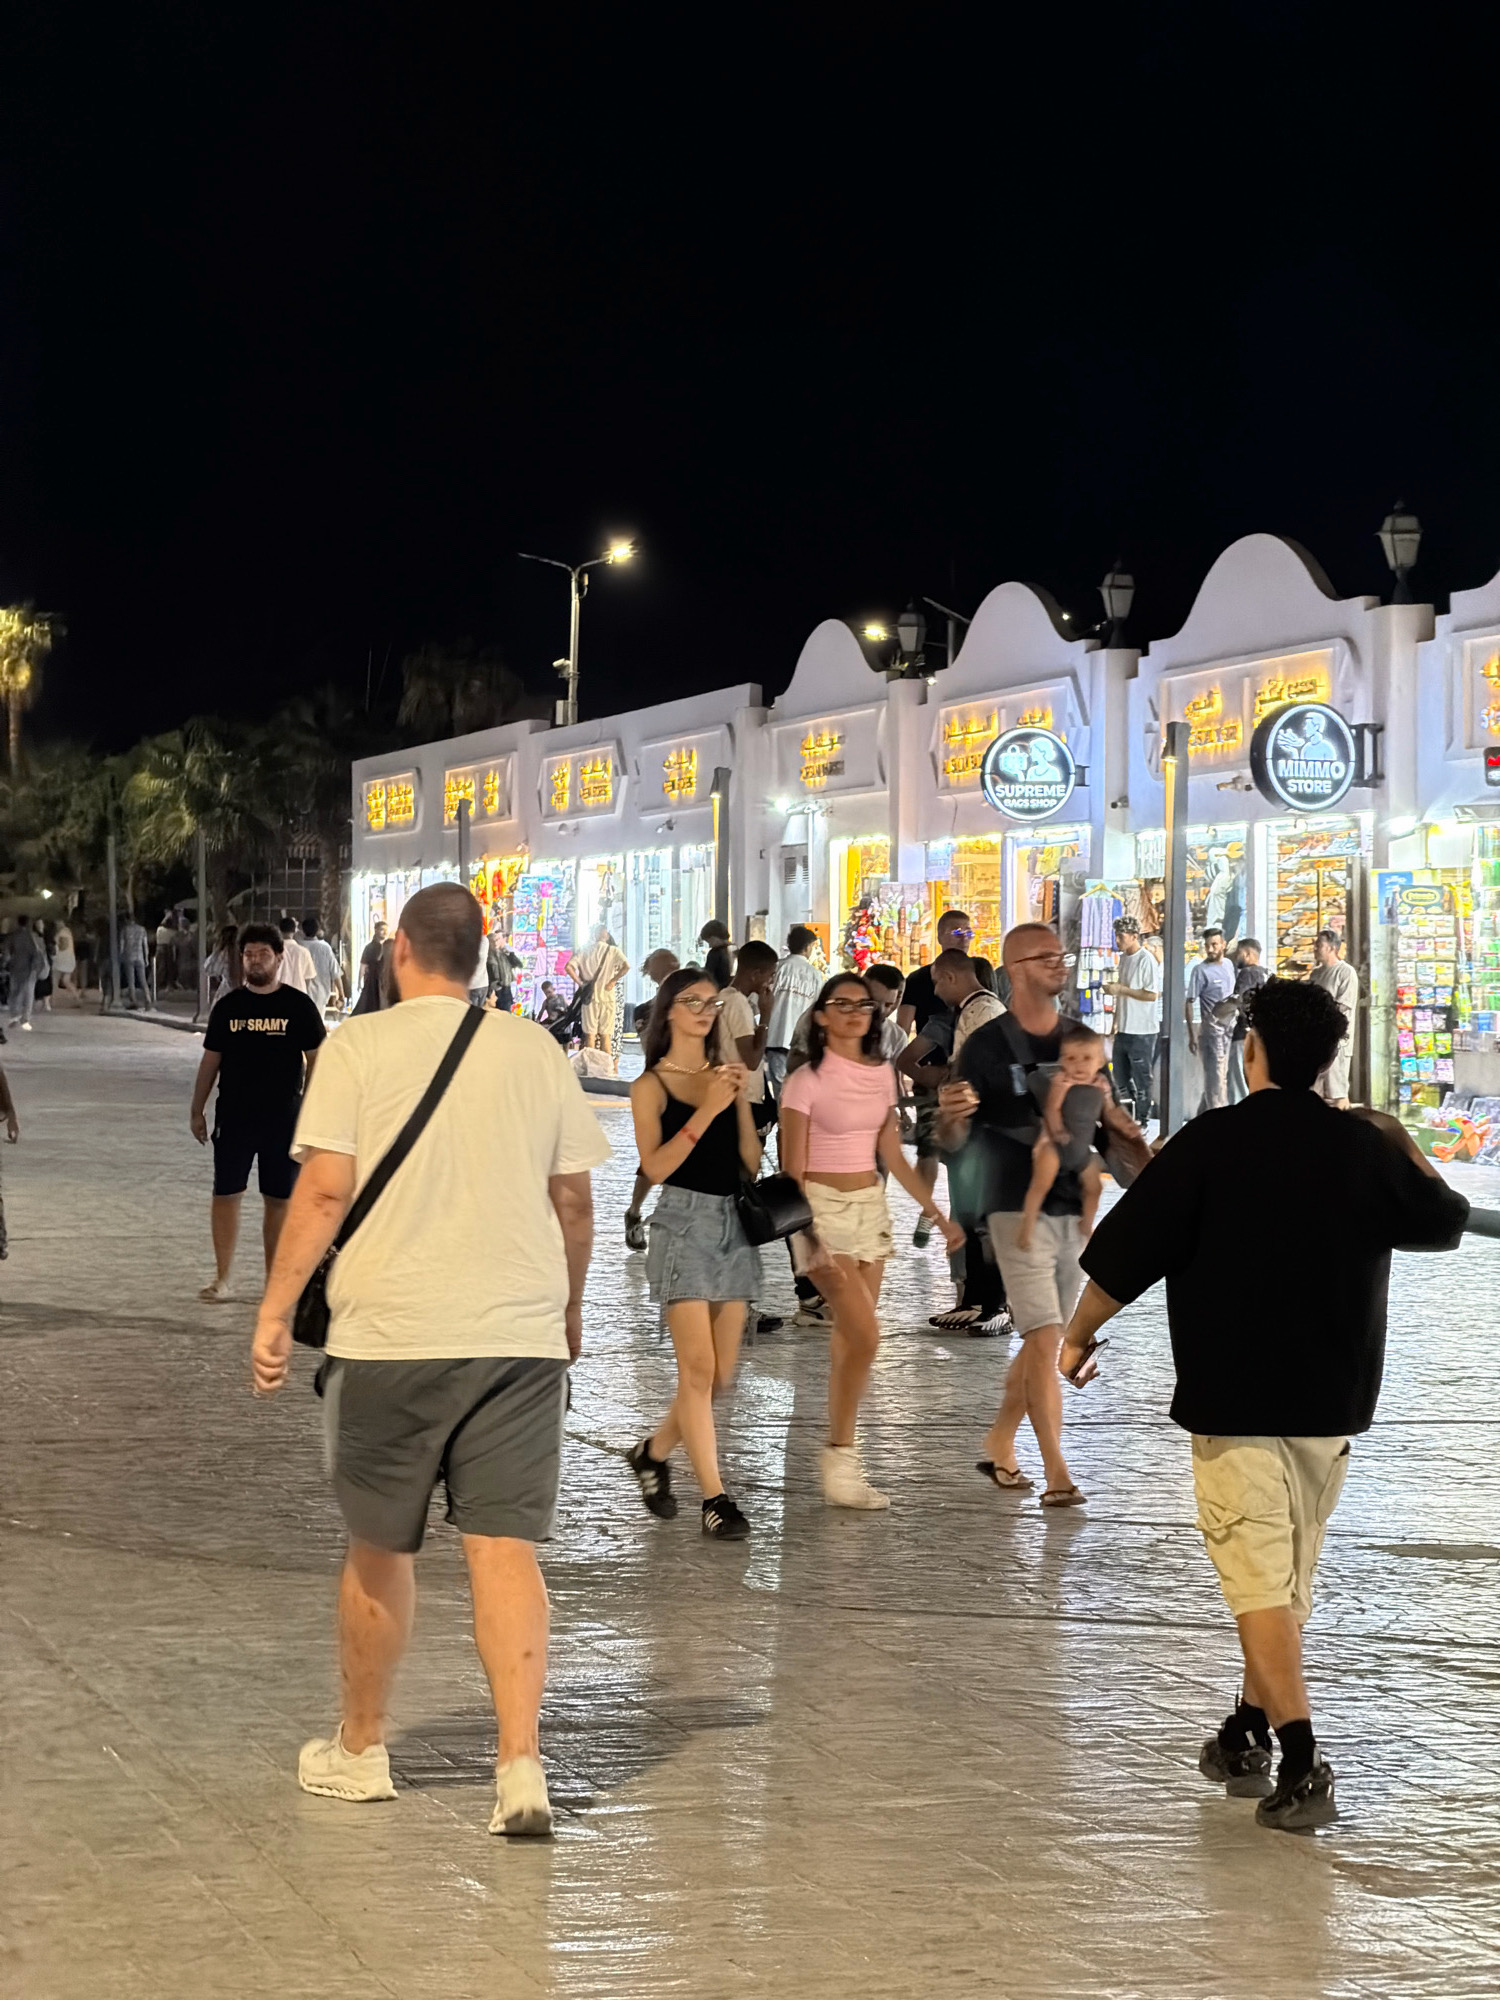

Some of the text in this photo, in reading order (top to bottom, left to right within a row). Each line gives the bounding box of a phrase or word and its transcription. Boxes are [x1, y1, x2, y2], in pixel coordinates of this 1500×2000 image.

[1278, 759, 1346, 780] MIMMO
[995, 784, 1066, 797] SUPREME
[1287, 779, 1332, 793] STORE
[1003, 798, 1057, 808] BAGS SHOP
